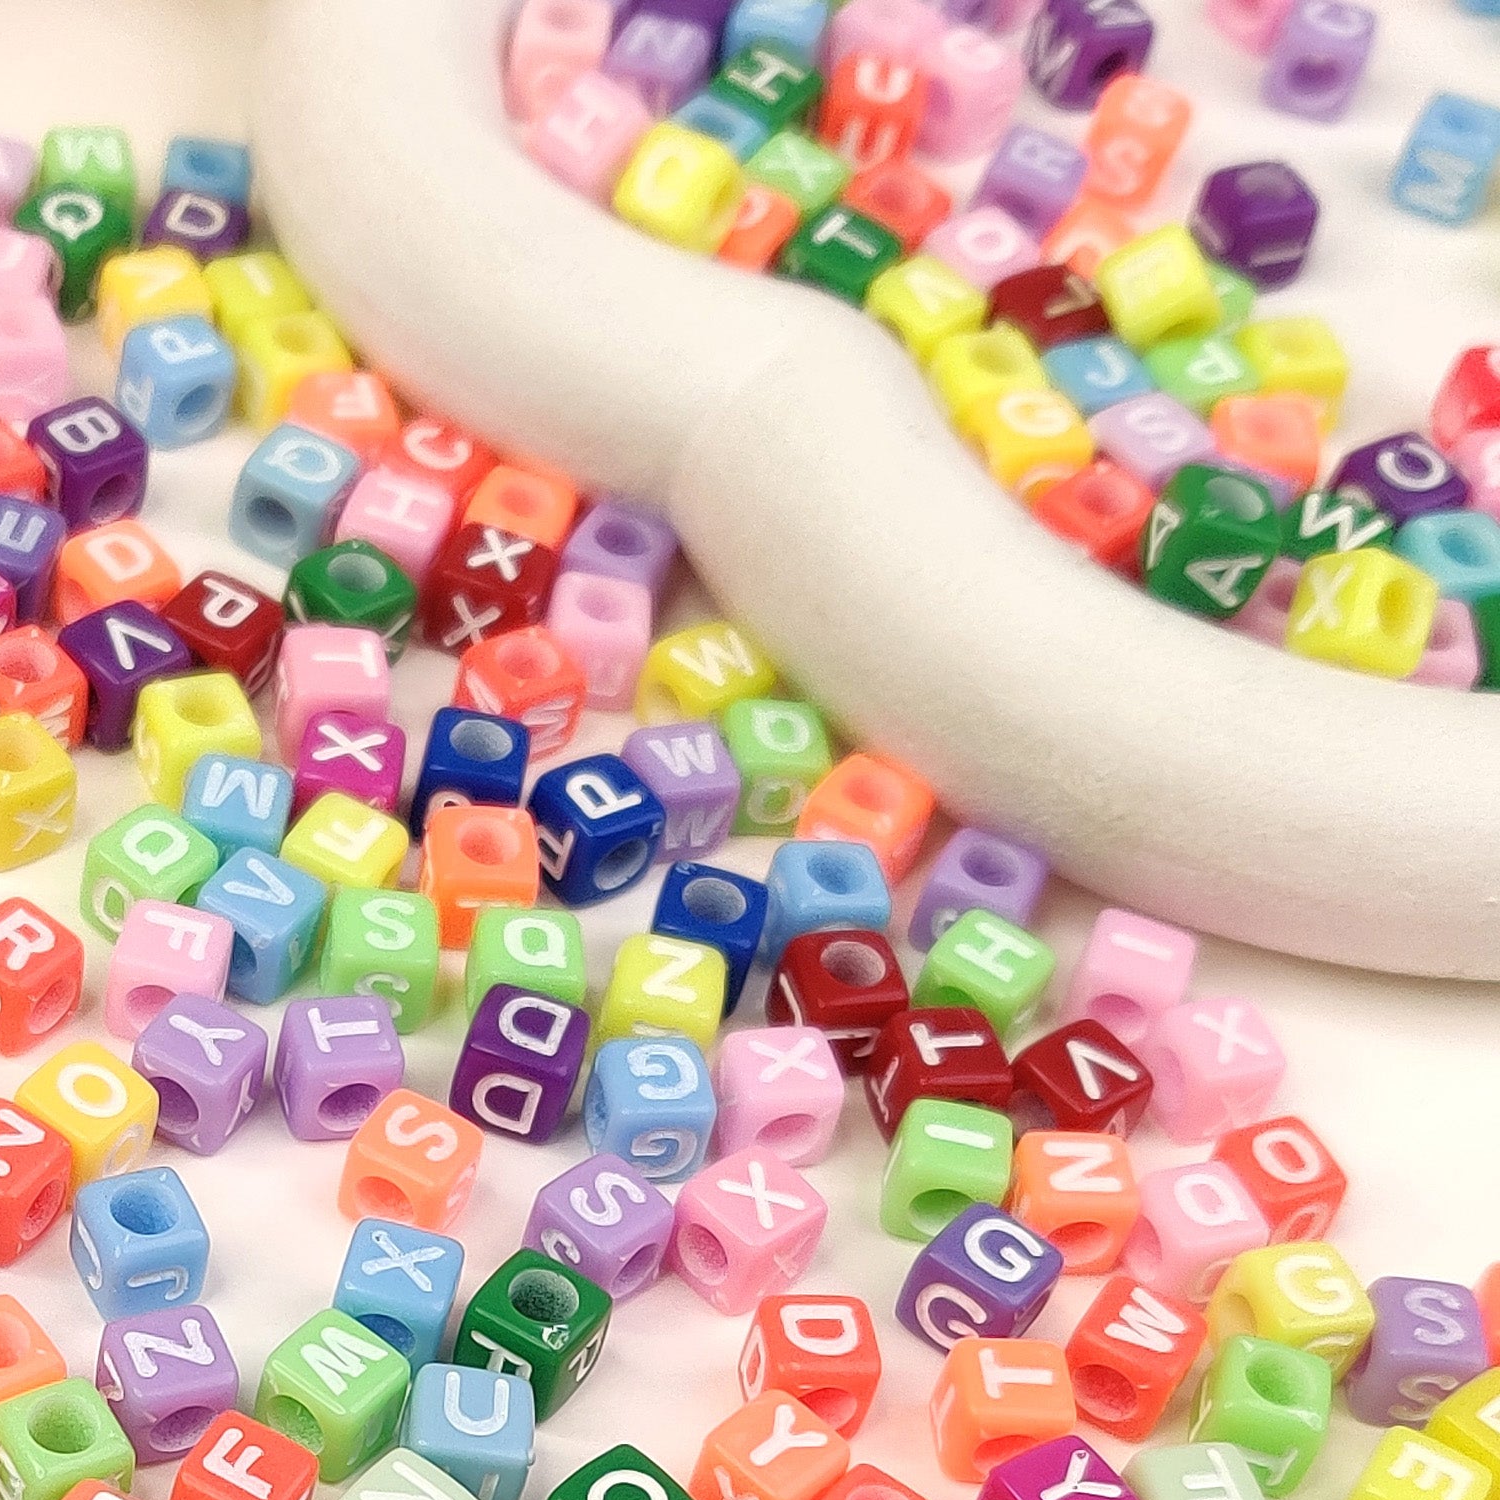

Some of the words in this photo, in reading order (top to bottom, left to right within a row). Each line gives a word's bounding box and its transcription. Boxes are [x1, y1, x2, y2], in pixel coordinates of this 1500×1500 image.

[728, 50, 806, 103] H
[857, 59, 914, 103] U
[40, 192, 103, 239] Q
[165, 192, 228, 237] D
[812, 212, 877, 257] T
[149, 327, 221, 363] P
[1086, 346, 1124, 387] J
[47, 410, 120, 453] B
[1125, 407, 1189, 452] S
[362, 481, 433, 533] H
[202, 578, 259, 626] P
[1184, 557, 1262, 609] A
[105, 616, 171, 670] V
[311, 724, 388, 772] X
[566, 773, 642, 819] P
[121, 820, 192, 875] Q
[313, 816, 389, 861] F
[144, 913, 214, 961] F
[360, 898, 416, 951] S
[503, 917, 567, 968] Q
[953, 920, 1038, 984] H
[169, 1014, 247, 1066] Y
[499, 997, 575, 1056] D
[909, 1022, 985, 1065] T
[57, 1062, 128, 1117] O
[1064, 1039, 1139, 1099] V
[471, 1074, 542, 1135] D
[384, 1105, 458, 1161] S
[570, 1171, 648, 1226] S
[716, 1161, 805, 1230] X
[361, 1230, 446, 1292] X
[964, 1218, 1045, 1282] G
[779, 1305, 861, 1356] D
[1404, 1289, 1466, 1346] S
[442, 1370, 509, 1436] U
[203, 1428, 273, 1500] F
